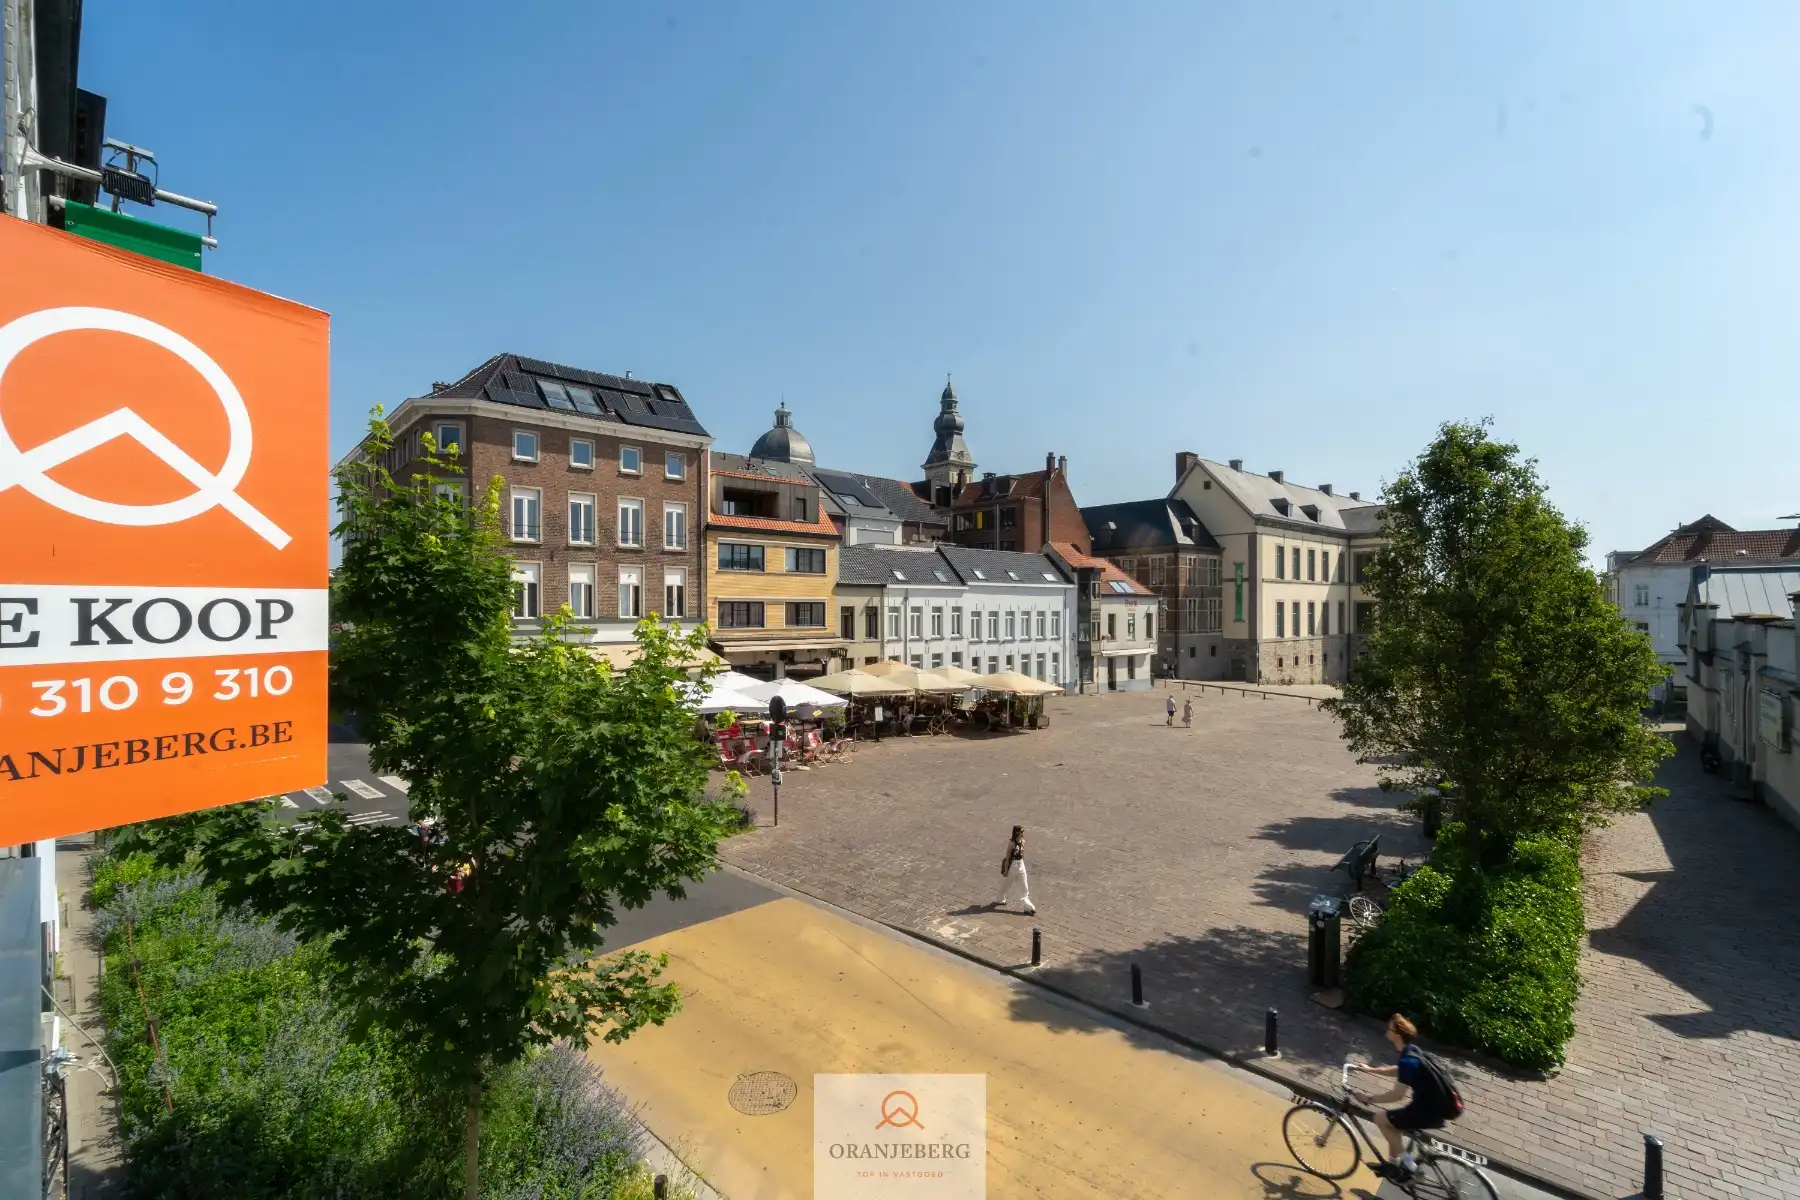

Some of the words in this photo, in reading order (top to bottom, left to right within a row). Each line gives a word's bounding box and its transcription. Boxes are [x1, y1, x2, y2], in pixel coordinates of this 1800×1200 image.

[69, 597, 294, 646] KOOP
[29, 675, 139, 717] 310
[161, 671, 193, 705] 9
[213, 665, 293, 700] 310
